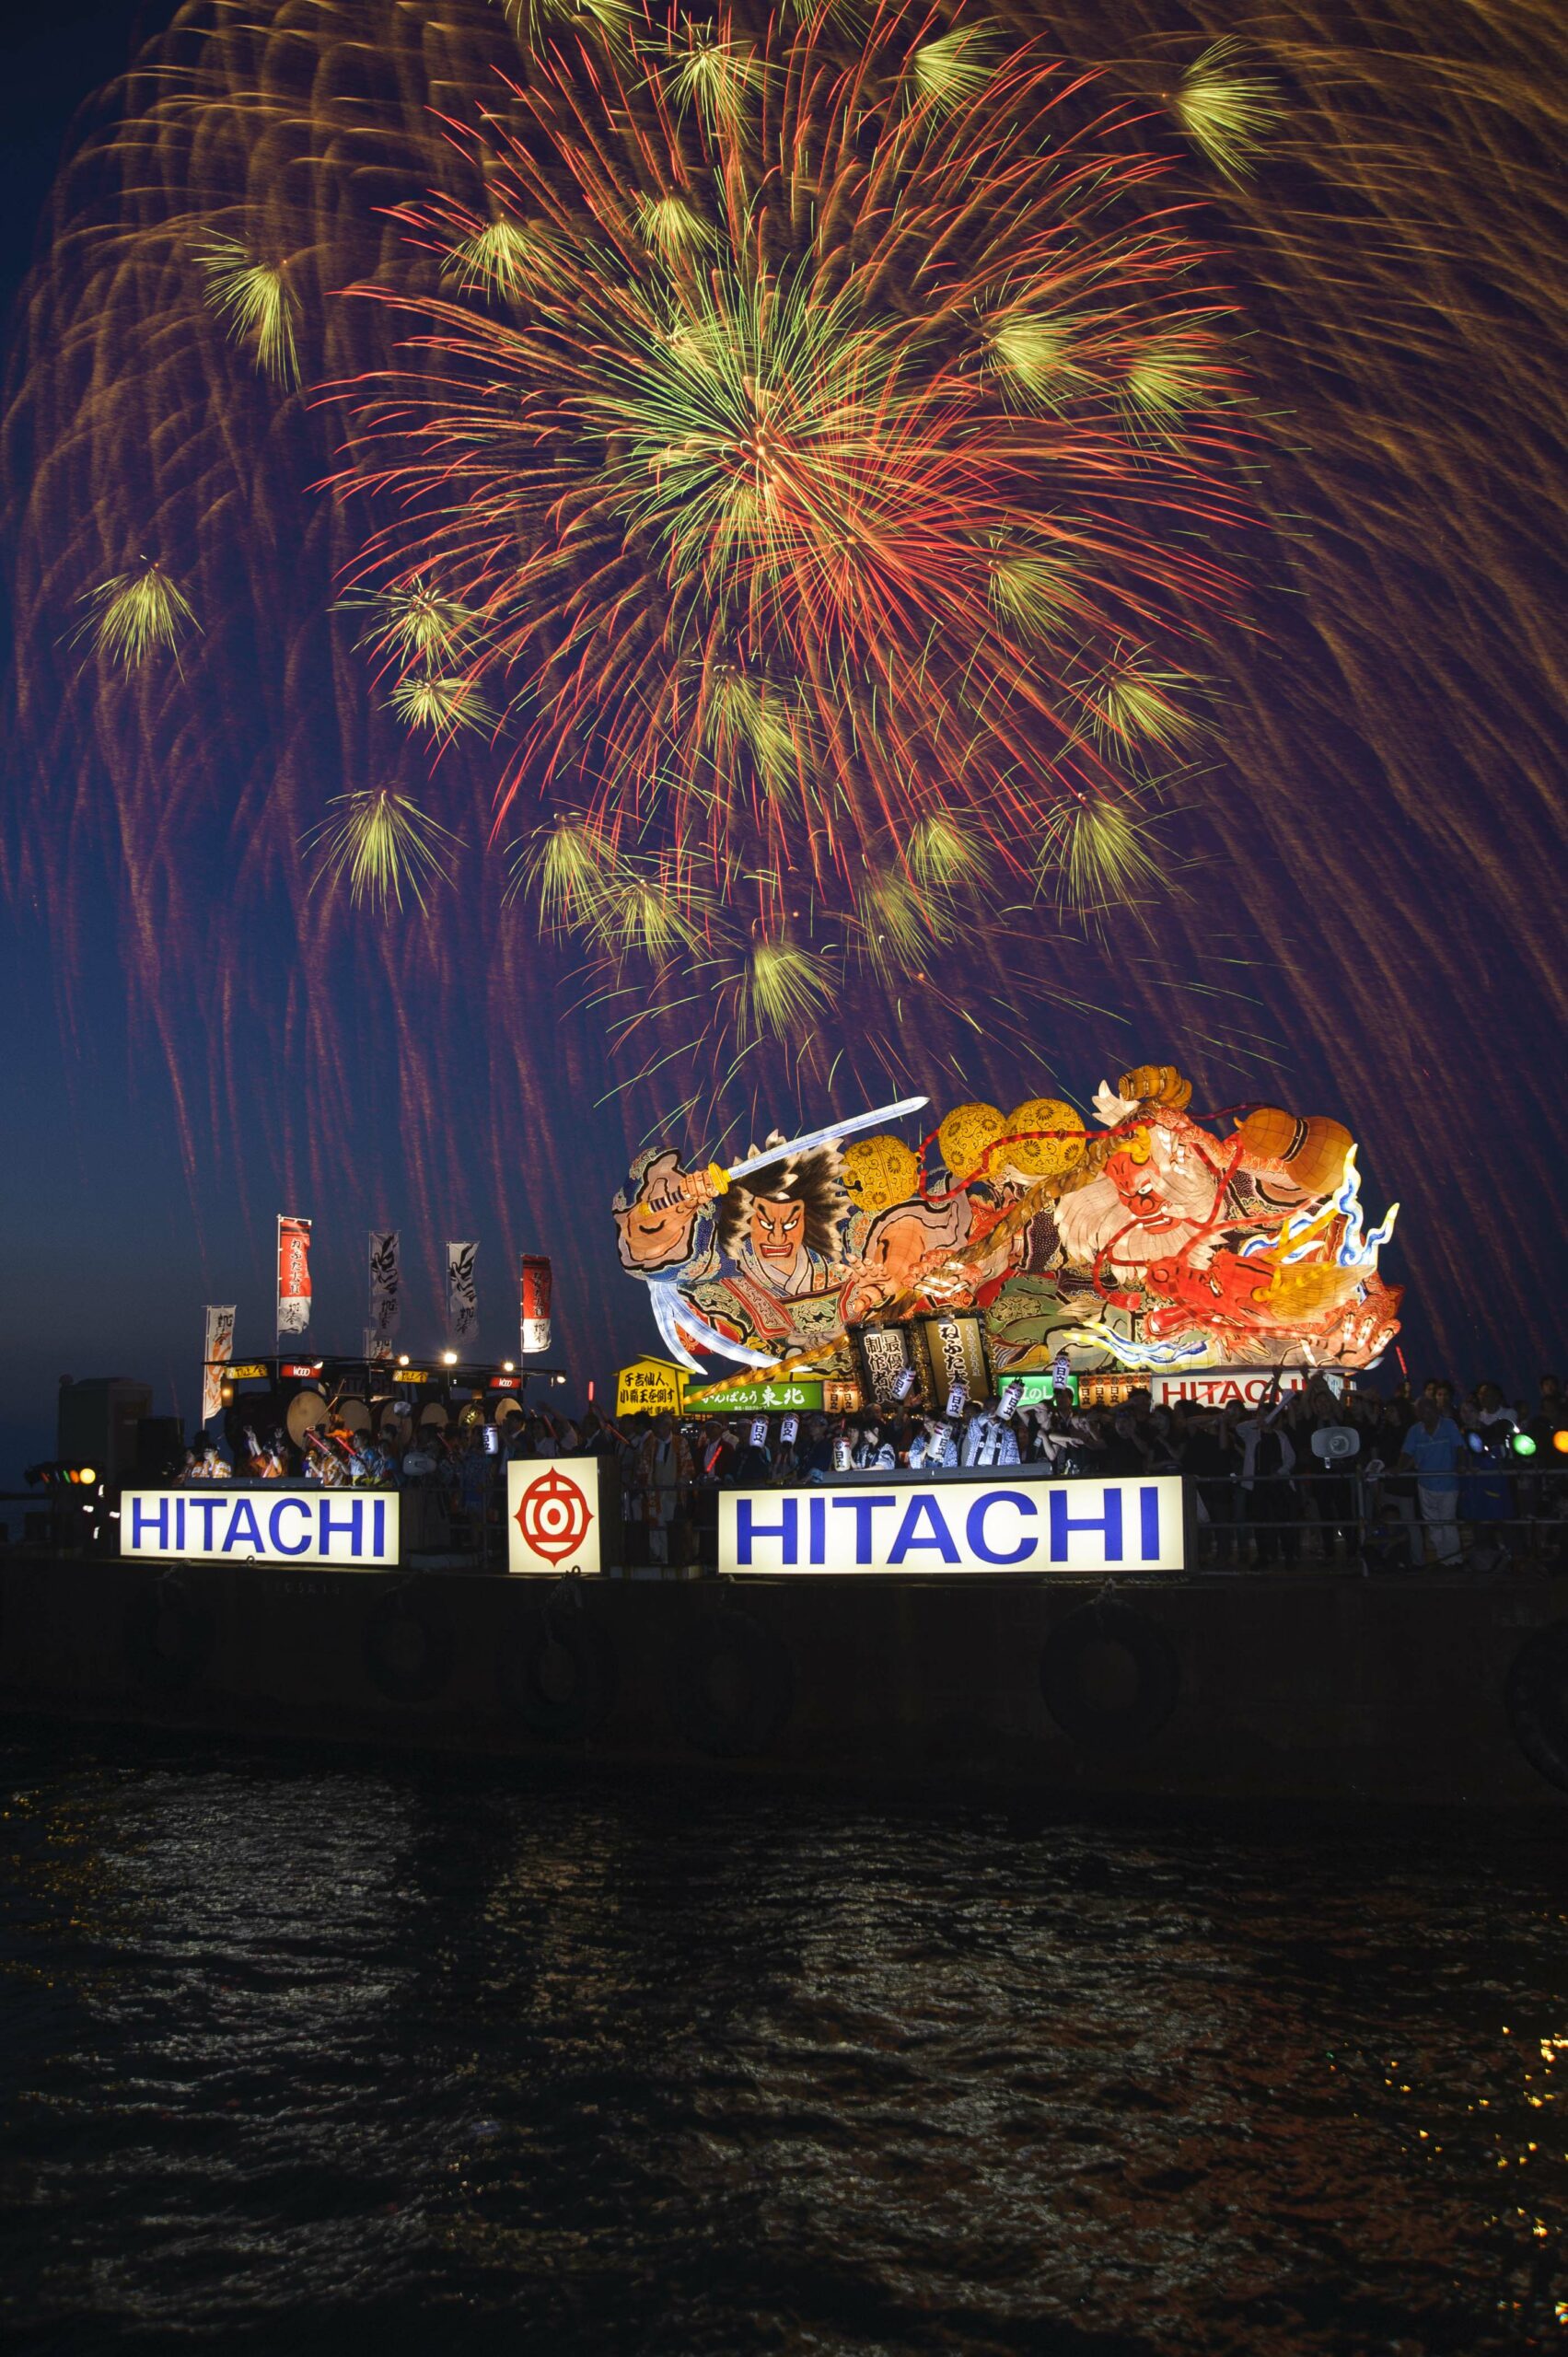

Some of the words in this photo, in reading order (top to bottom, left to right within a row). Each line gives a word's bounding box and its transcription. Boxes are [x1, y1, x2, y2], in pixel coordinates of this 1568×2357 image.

[864, 1336, 894, 1405] 制作者賞
[939, 1324, 970, 1400] ねぶた大
[1054, 1366, 1066, 1385] 日立
[893, 1378, 904, 1398] 日立
[1081, 1387, 1091, 1405] 日立
[1096, 1387, 1105, 1404] 日立
[1110, 1386, 1120, 1403] 日立
[830, 1393, 839, 1410] 日立
[843, 1393, 854, 1409] 日立
[950, 1395, 962, 1414] 日立
[1003, 1397, 1019, 1416] 日立
[753, 1424, 765, 1443] 日立
[782, 1422, 793, 1437] 日立
[935, 1437, 948, 1456] 日立
[834, 1450, 845, 1469] 日立
[133, 1497, 385, 1557] HITACHI
[736, 1486, 1160, 1566] HITACHI
